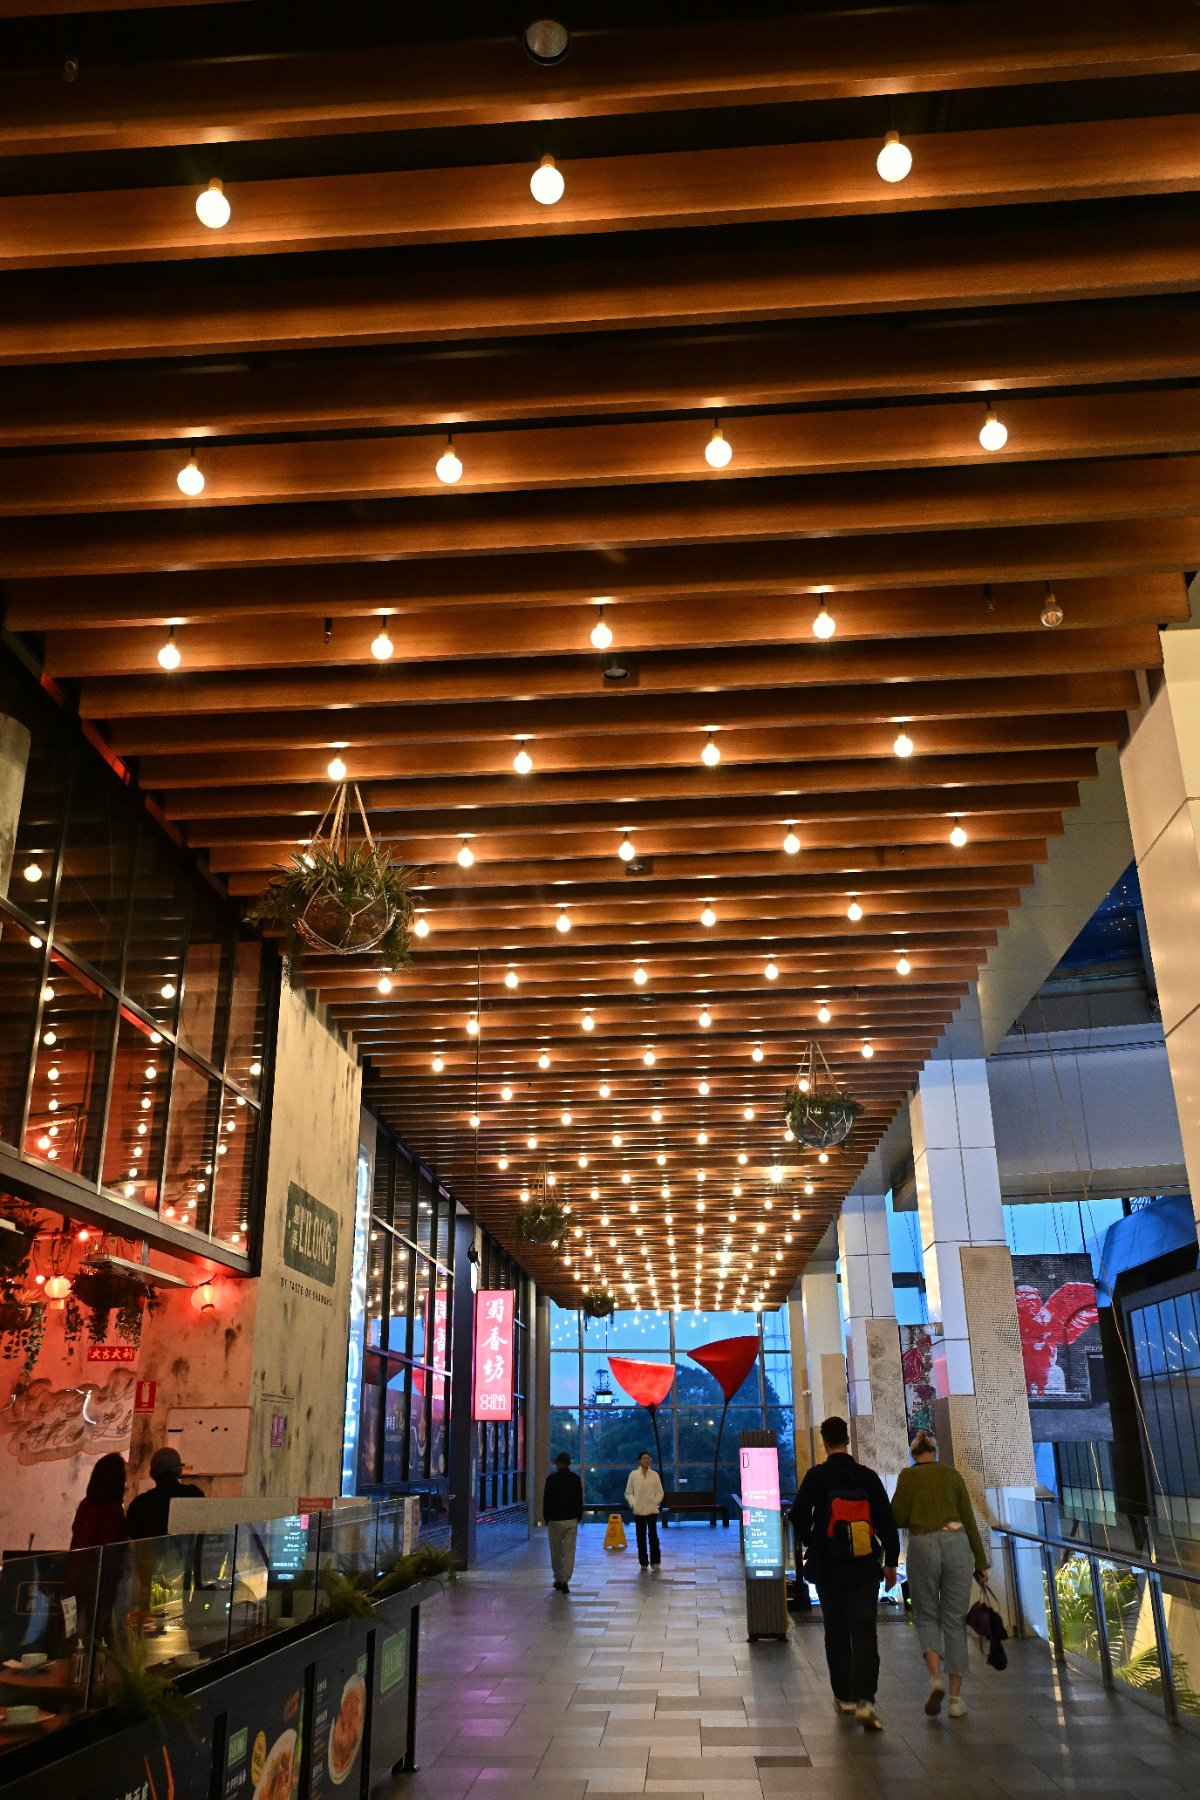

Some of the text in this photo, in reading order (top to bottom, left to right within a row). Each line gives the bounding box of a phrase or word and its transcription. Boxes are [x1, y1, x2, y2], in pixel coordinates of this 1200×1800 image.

[298, 1206, 332, 1266] LILONG
[280, 1277, 288, 1288] BY
[289, 1280, 304, 1295] TASTE
[305, 1287, 312, 1298] OF
[90, 1347, 133, 1360] 大吉大利
[481, 1298, 508, 1383] 蜀香坊
